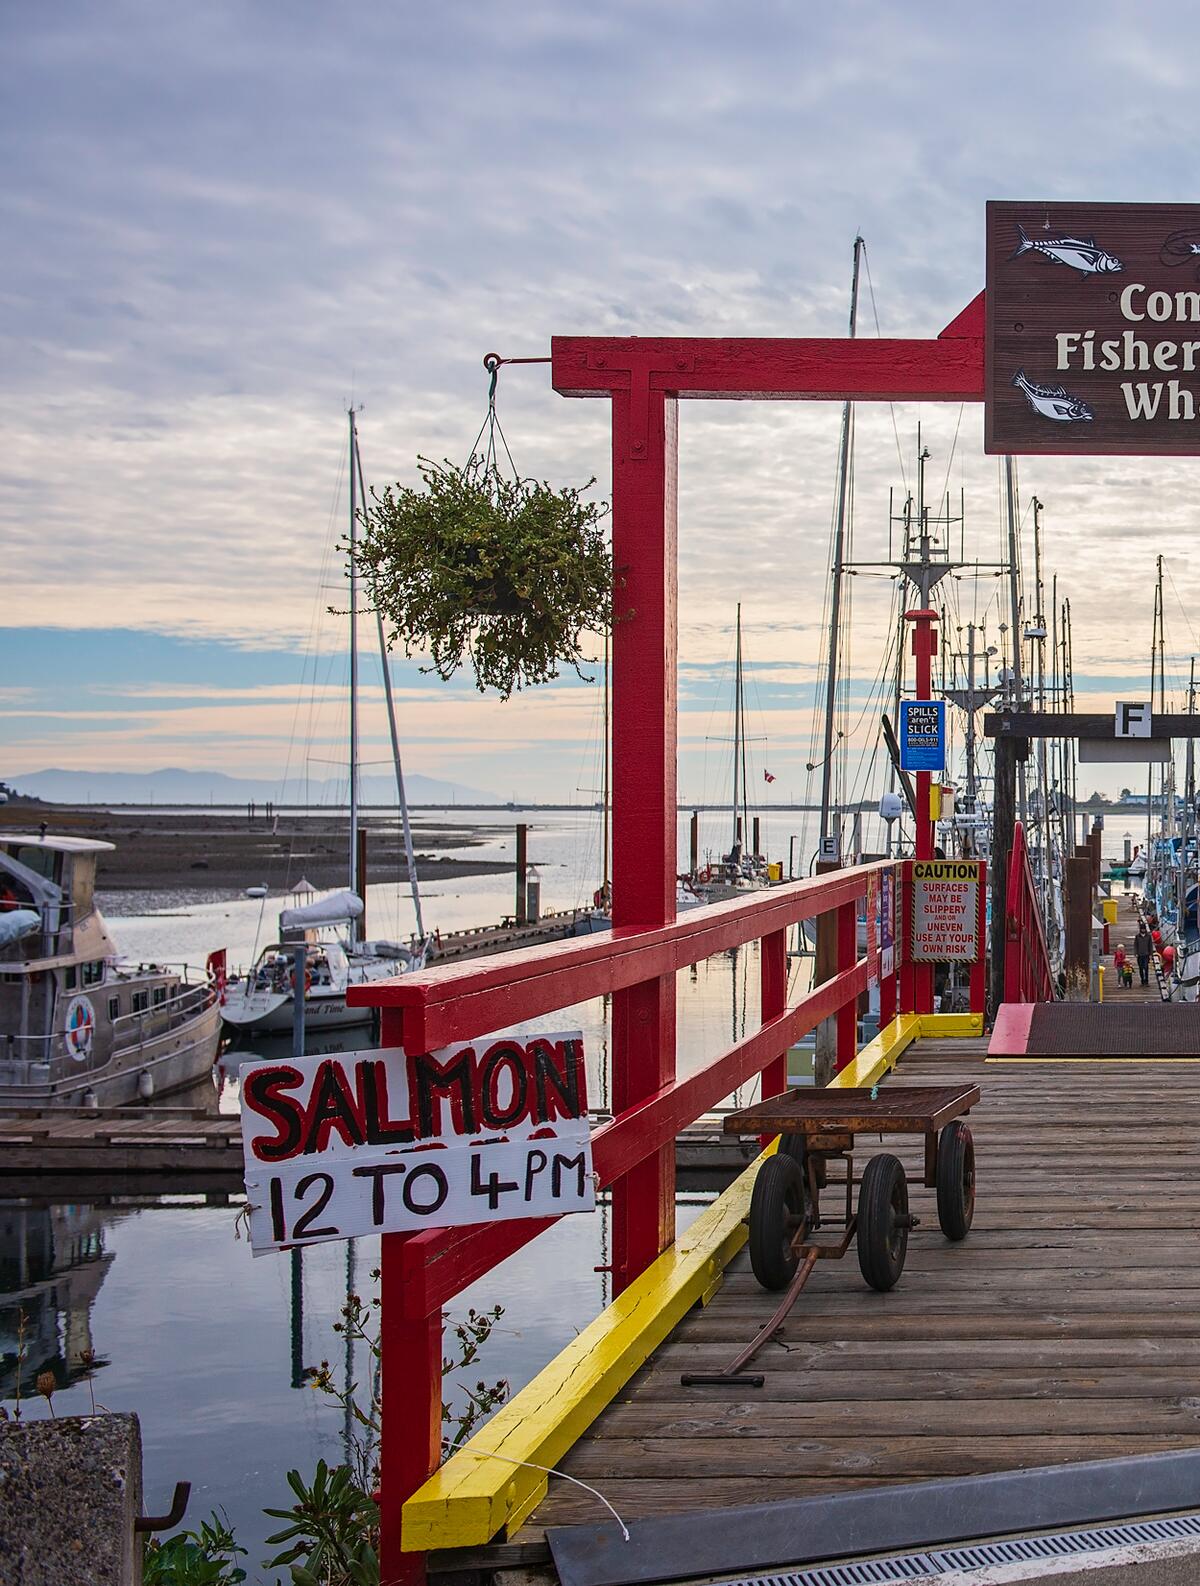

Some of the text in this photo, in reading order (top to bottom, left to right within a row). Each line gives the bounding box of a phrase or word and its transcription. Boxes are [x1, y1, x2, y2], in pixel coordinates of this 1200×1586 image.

[907, 707, 938, 716] SPILLS
[911, 716, 935, 724] aren't
[1122, 704, 1145, 734] F
[908, 725, 938, 734] SLICK
[824, 840, 834, 853] E
[914, 864, 977, 879] CAUTION
[922, 883, 969, 892] SURFACES
[928, 895, 962, 903] MAY BE
[923, 905, 967, 914] SLIPPERY
[927, 923, 963, 932] UNEVEN
[916, 934, 933, 942] USE
[949, 935, 974, 943] YOUR
[922, 945, 967, 953] OWN RISK
[243, 1037, 588, 1163] SALMON
[270, 1172, 340, 1242] 12
[352, 1162, 449, 1226] TO
